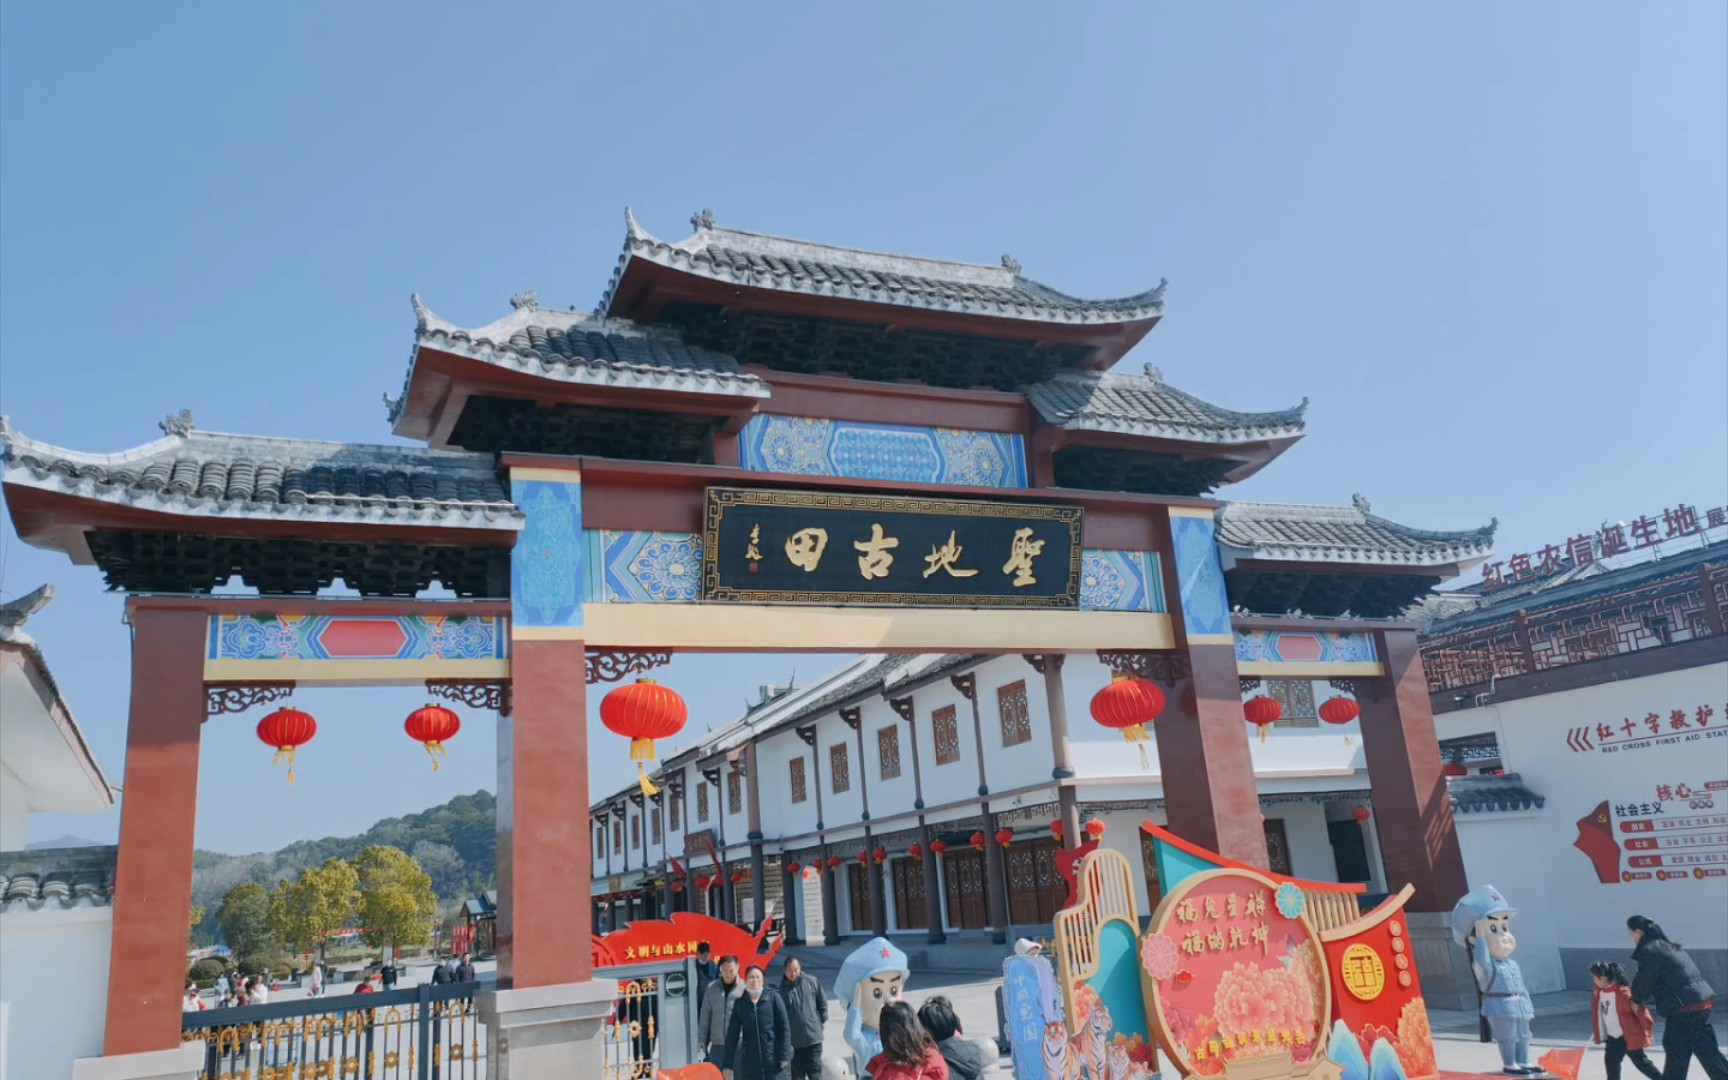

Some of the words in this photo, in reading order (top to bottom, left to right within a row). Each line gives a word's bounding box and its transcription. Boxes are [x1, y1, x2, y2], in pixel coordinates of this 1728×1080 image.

[1597, 702, 1728, 742] 红十字救护
[1622, 741, 1651, 751] CROSS
[1656, 737, 1681, 746] FIRST
[1685, 734, 1700, 742] AID
[1656, 783, 1692, 801] 核心
[1615, 802, 1664, 817] 社会主义
[626, 940, 710, 959] 文明与山水同
